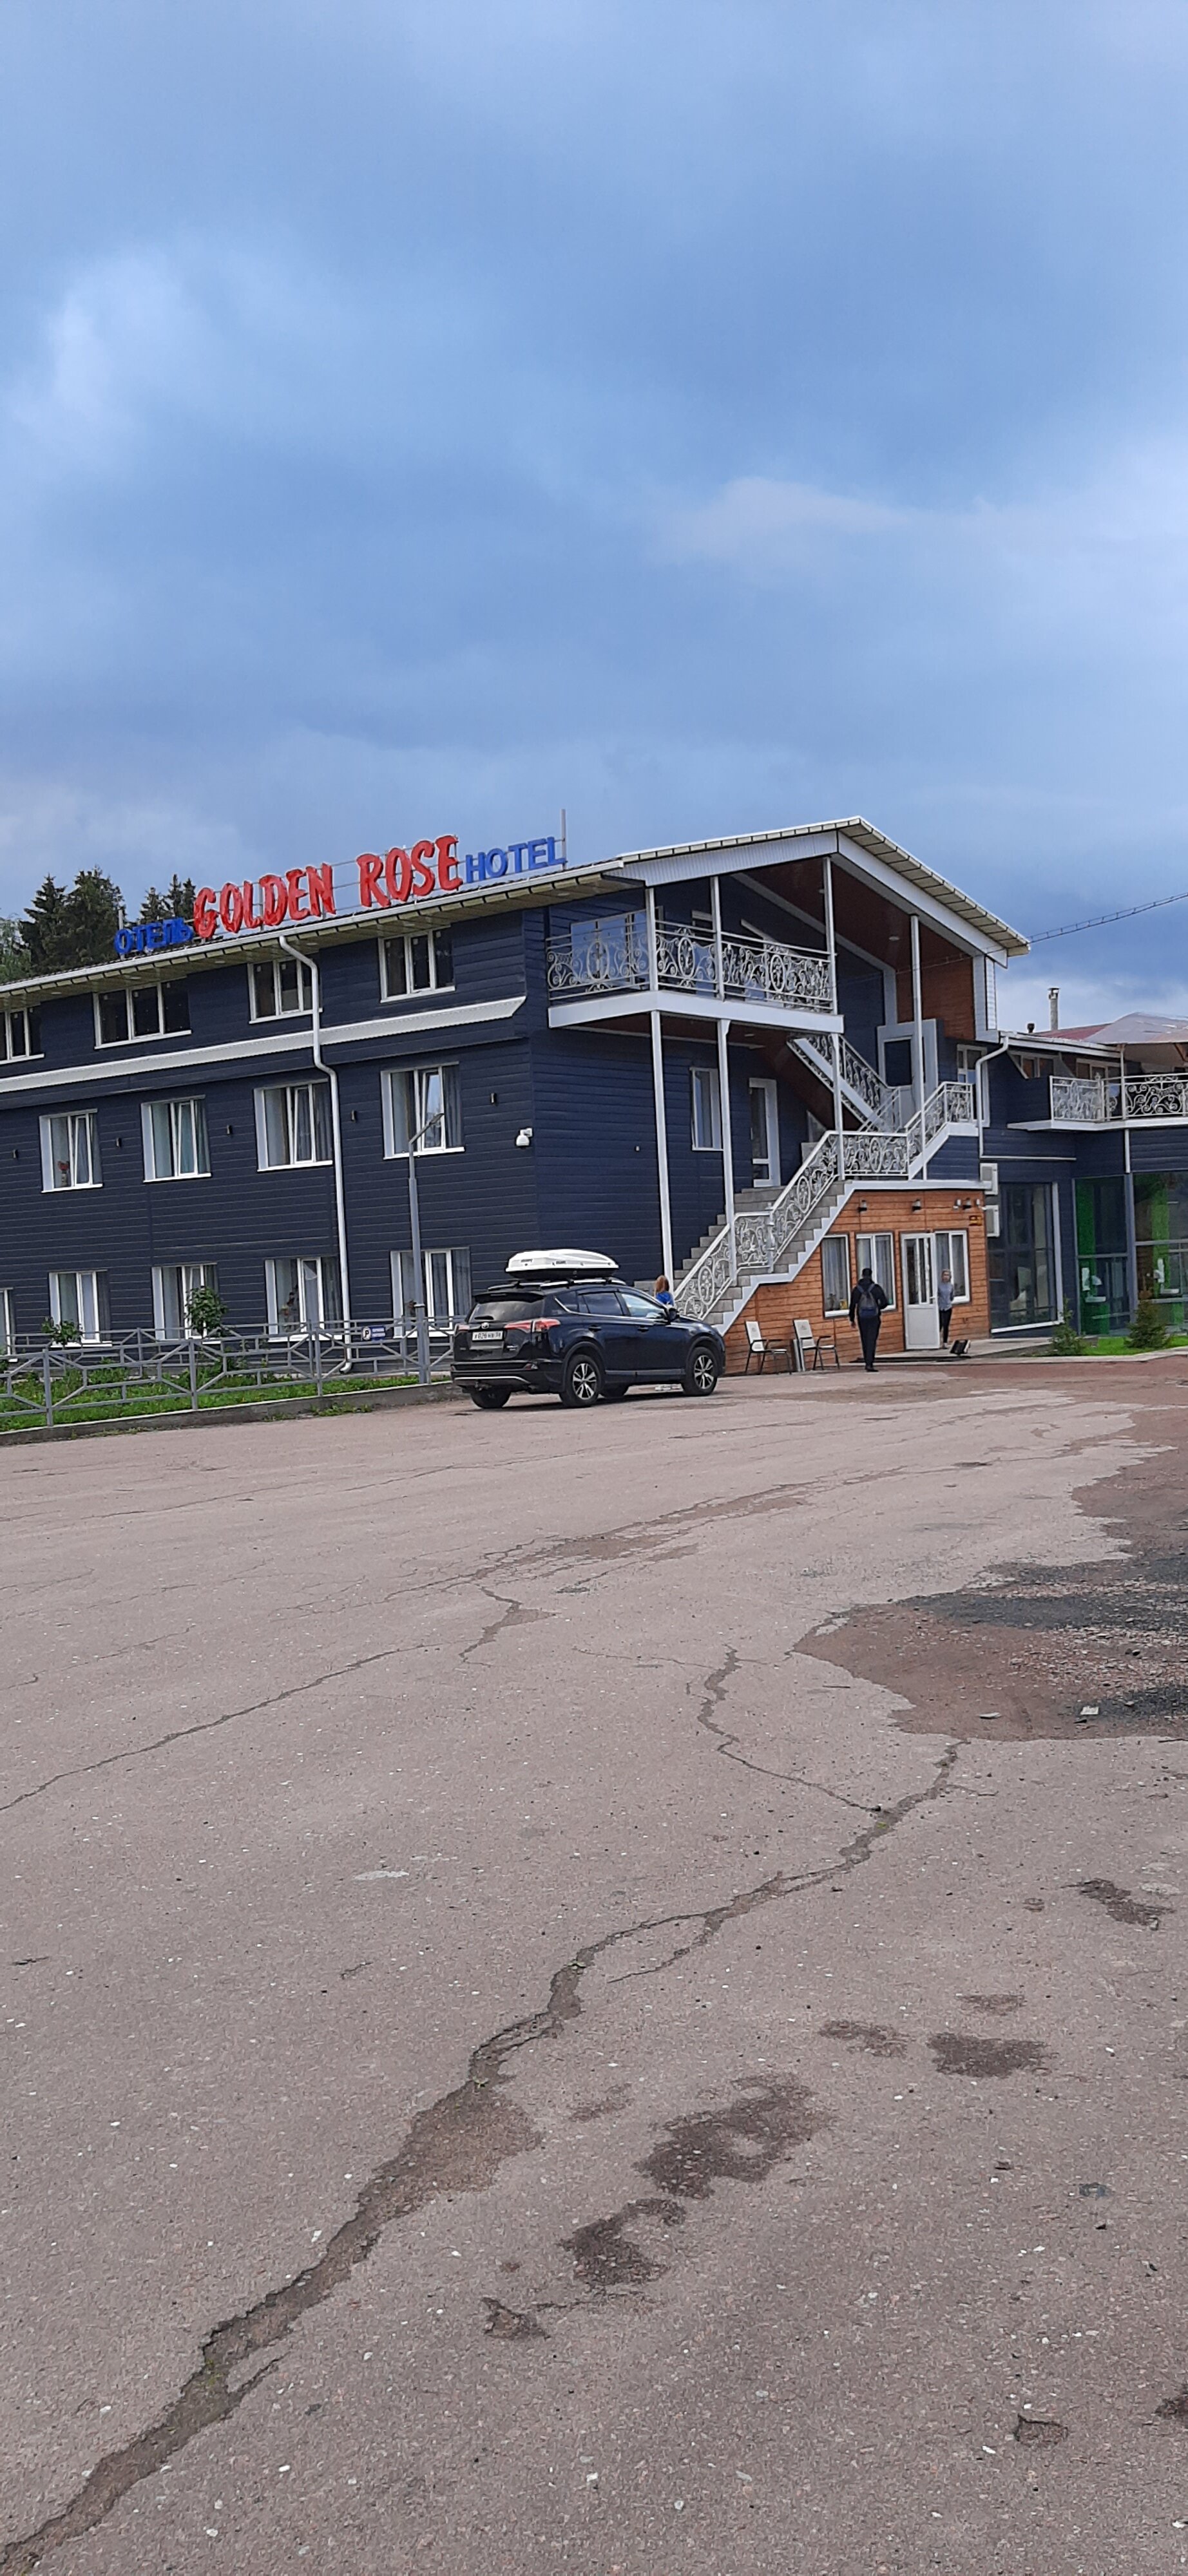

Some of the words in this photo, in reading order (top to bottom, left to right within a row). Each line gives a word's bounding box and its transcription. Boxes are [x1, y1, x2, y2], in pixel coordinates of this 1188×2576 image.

[194, 862, 336, 938] GOLDEN
[356, 835, 463, 907] ROSE
[465, 837, 566, 884] HOTEL
[114, 917, 193, 954] ОТЕЛЬ
